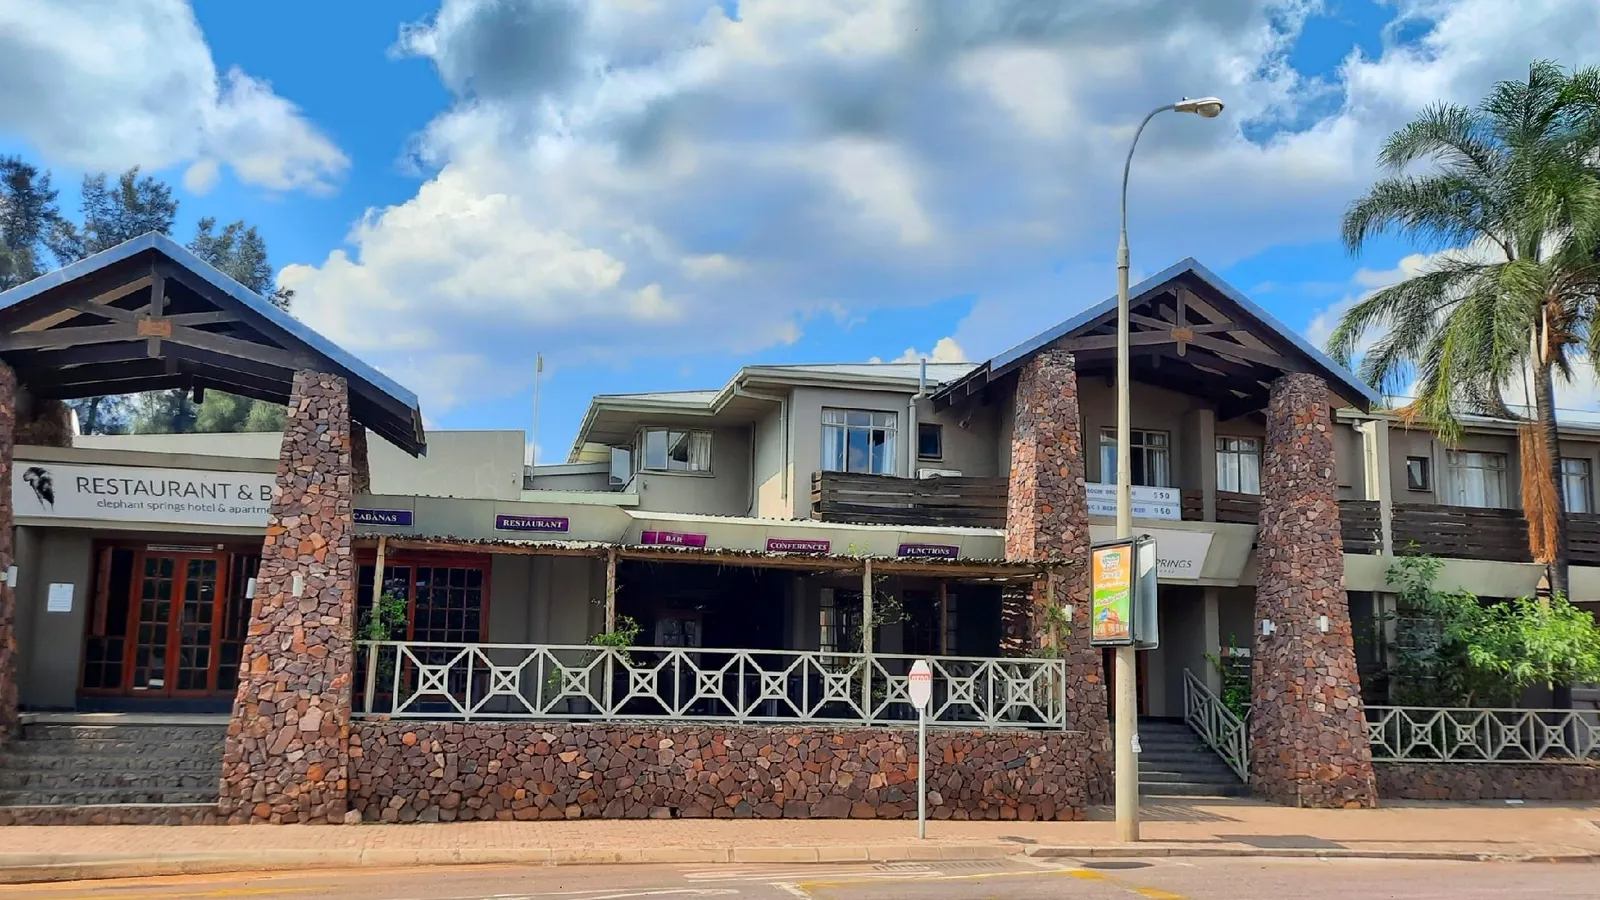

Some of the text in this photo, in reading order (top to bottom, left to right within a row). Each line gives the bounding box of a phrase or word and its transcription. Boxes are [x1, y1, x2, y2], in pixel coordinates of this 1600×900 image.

[76, 476, 232, 500] RESTAURANT
[237, 484, 254, 501] &
[96, 499, 271, 514] elephant springs hotel & apartme
[353, 512, 397, 522] CABANAS
[503, 519, 563, 529] RESTAURANT
[665, 535, 683, 543] BAR
[770, 542, 828, 551] CONFERENCES
[906, 547, 950, 555] FUNCTIONS
[1156, 558, 1193, 569] PRINGS
